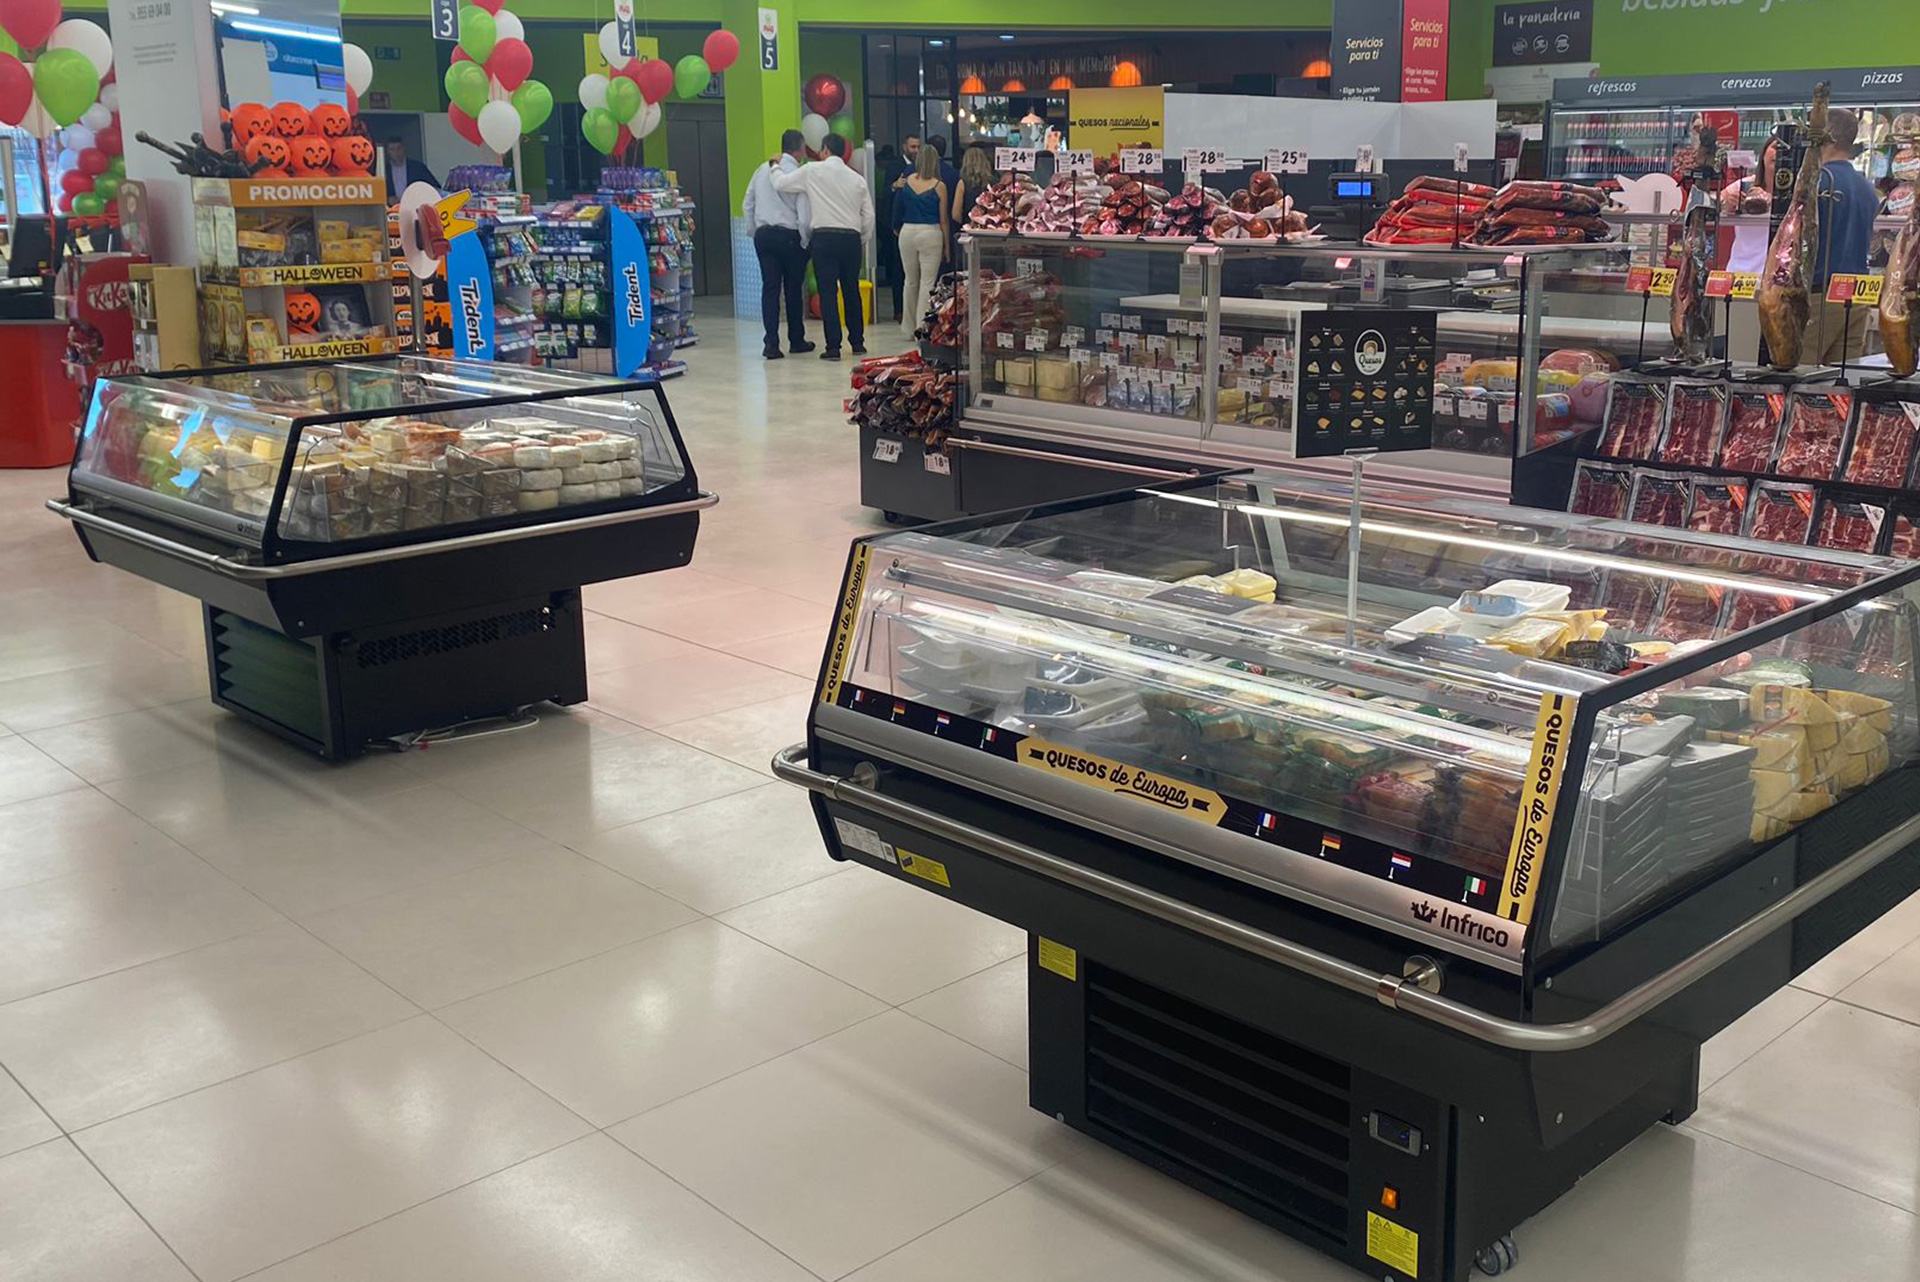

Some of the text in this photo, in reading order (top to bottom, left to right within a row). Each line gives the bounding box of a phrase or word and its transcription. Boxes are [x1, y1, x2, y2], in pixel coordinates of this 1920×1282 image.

[440, 8, 453, 36] 3
[1410, 18, 1443, 34] Servicios
[1503, 12, 1514, 26] la
[621, 30, 631, 54] 4
[1345, 36, 1384, 49] Servicios
[1413, 36, 1439, 50] para ti
[765, 47, 774, 68] 5
[1349, 49, 1380, 64] para ti
[1721, 76, 1772, 89] cervezas
[1861, 71, 1903, 88] pizzas
[1587, 81, 1637, 96] refrescos
[1078, 114, 1150, 130] QUESOS nacionales
[1011, 151, 1027, 163] 24
[1070, 153, 1085, 165] 24
[1138, 152, 1153, 165] 28
[1199, 151, 1216, 164] 28
[1281, 151, 1298, 165] 25
[249, 184, 373, 201] PROMOCION
[274, 266, 363, 282] HALLOWEEN
[94, 282, 128, 309] KitKa
[624, 263, 644, 326] Trident
[460, 278, 486, 354] Trident
[282, 342, 370, 360] HALLOWEEN
[1358, 354, 1383, 368] Quesos
[827, 560, 866, 690] QUESOS de Europa
[1046, 749, 1189, 808] QUESOS de Europa
[1510, 713, 1563, 899] QUESOS de Europa
[1440, 906, 1509, 948] Infrico
